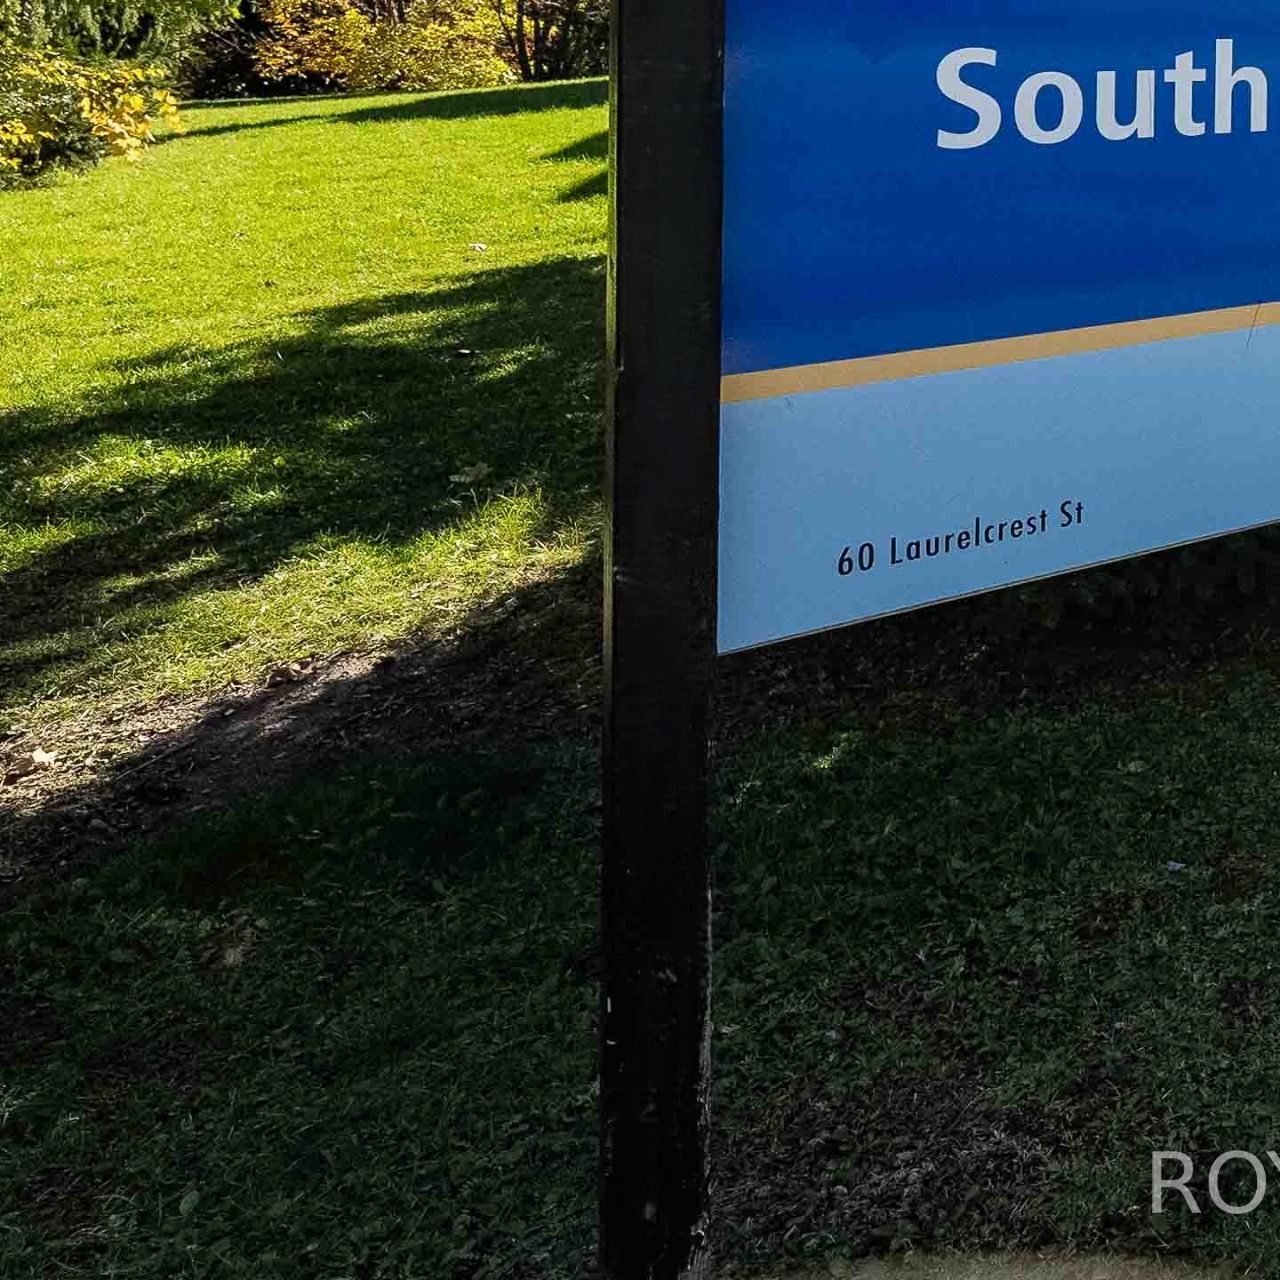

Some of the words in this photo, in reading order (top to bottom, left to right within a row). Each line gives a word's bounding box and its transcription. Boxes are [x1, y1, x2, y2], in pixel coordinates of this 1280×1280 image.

[935, 37, 1269, 149] South
[837, 542, 875, 576] 60
[890, 508, 1048, 565] Laurelcrest
[1060, 500, 1084, 528] St
